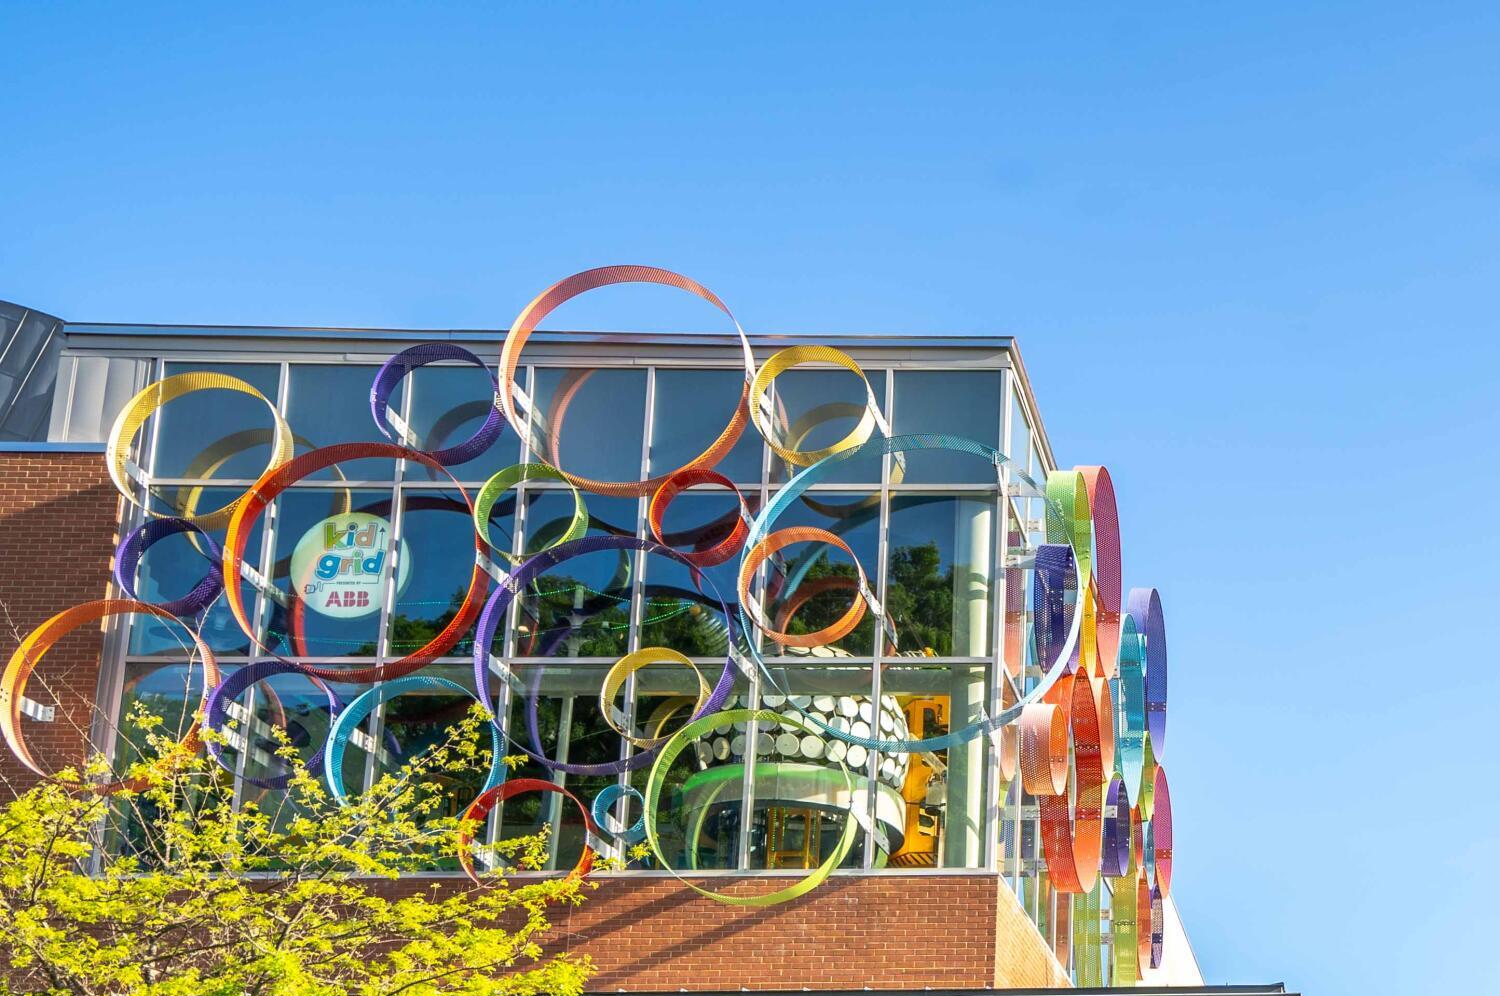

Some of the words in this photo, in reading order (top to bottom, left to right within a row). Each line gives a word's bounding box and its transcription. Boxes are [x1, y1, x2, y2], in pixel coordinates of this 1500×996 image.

[323, 522, 379, 551] kid
[315, 551, 386, 580] grid
[325, 591, 370, 607] ABB
